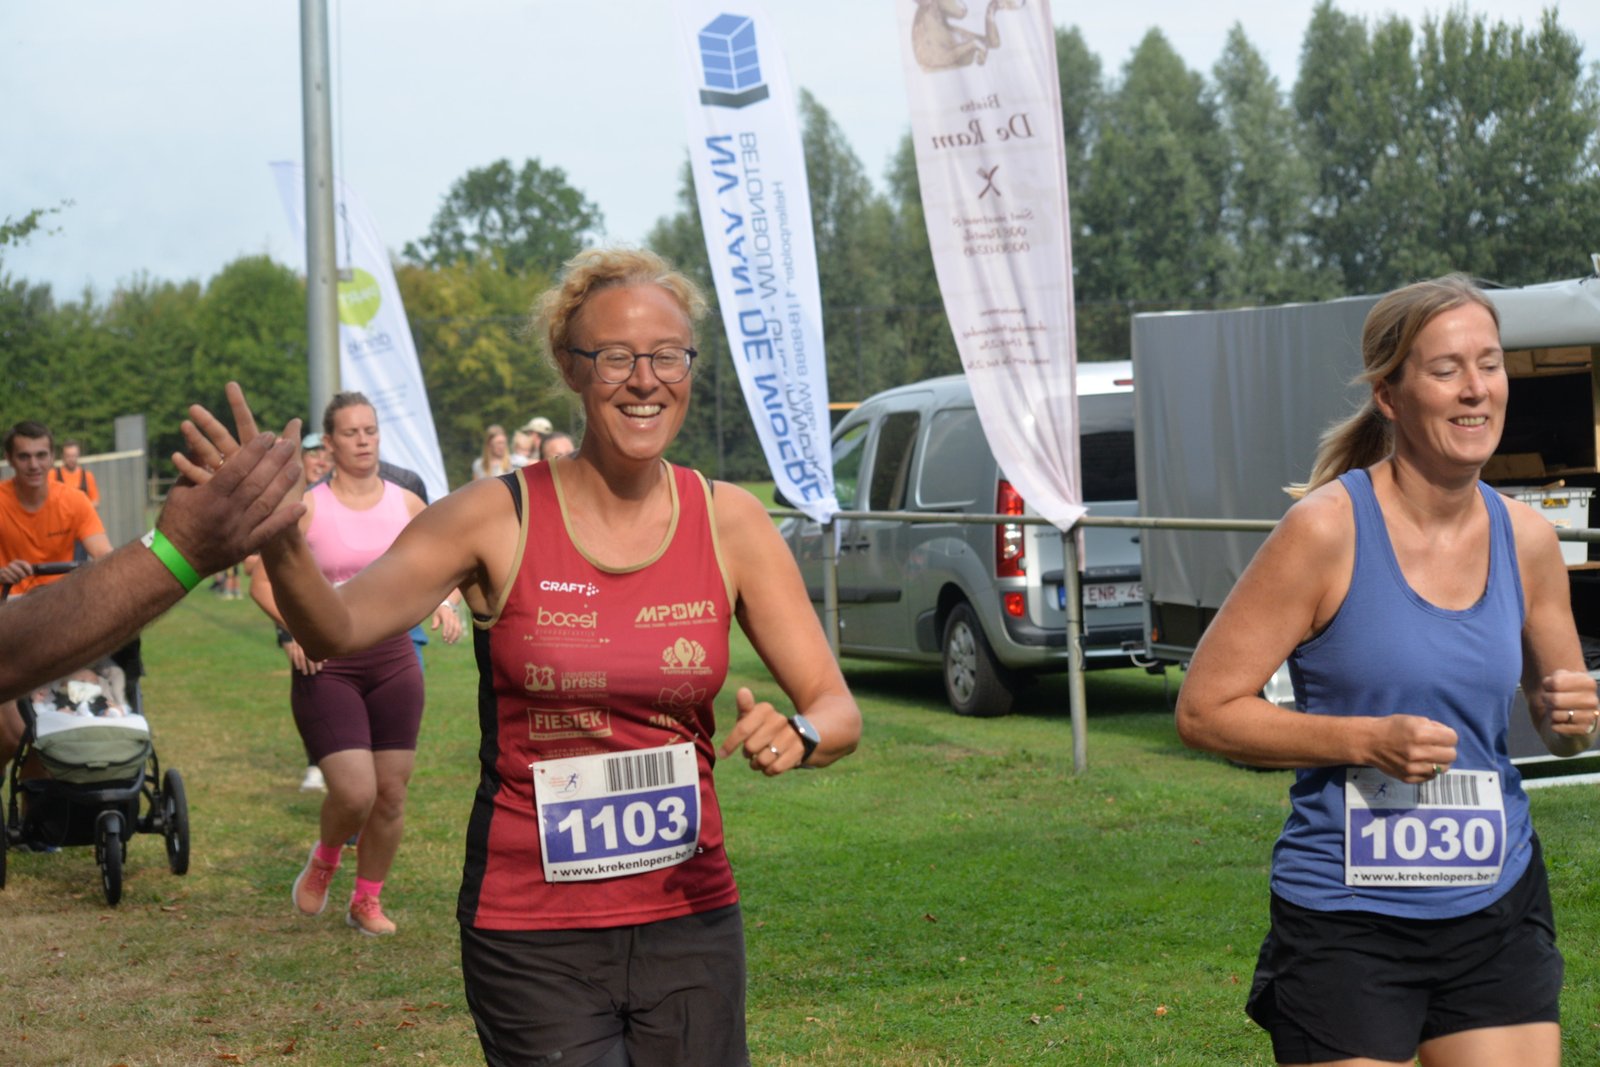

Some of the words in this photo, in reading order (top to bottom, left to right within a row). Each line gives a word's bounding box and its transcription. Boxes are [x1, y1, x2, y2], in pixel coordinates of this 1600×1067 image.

[540, 580, 586, 594] CRAFT
[635, 600, 717, 623] MPOWR
[561, 678, 608, 691] press
[558, 796, 689, 854] 1103
[1361, 816, 1495, 861] 1030
[559, 850, 687, 876] www.krekenlopers.be
[1361, 872, 1490, 884] www.krekenlopers.be
